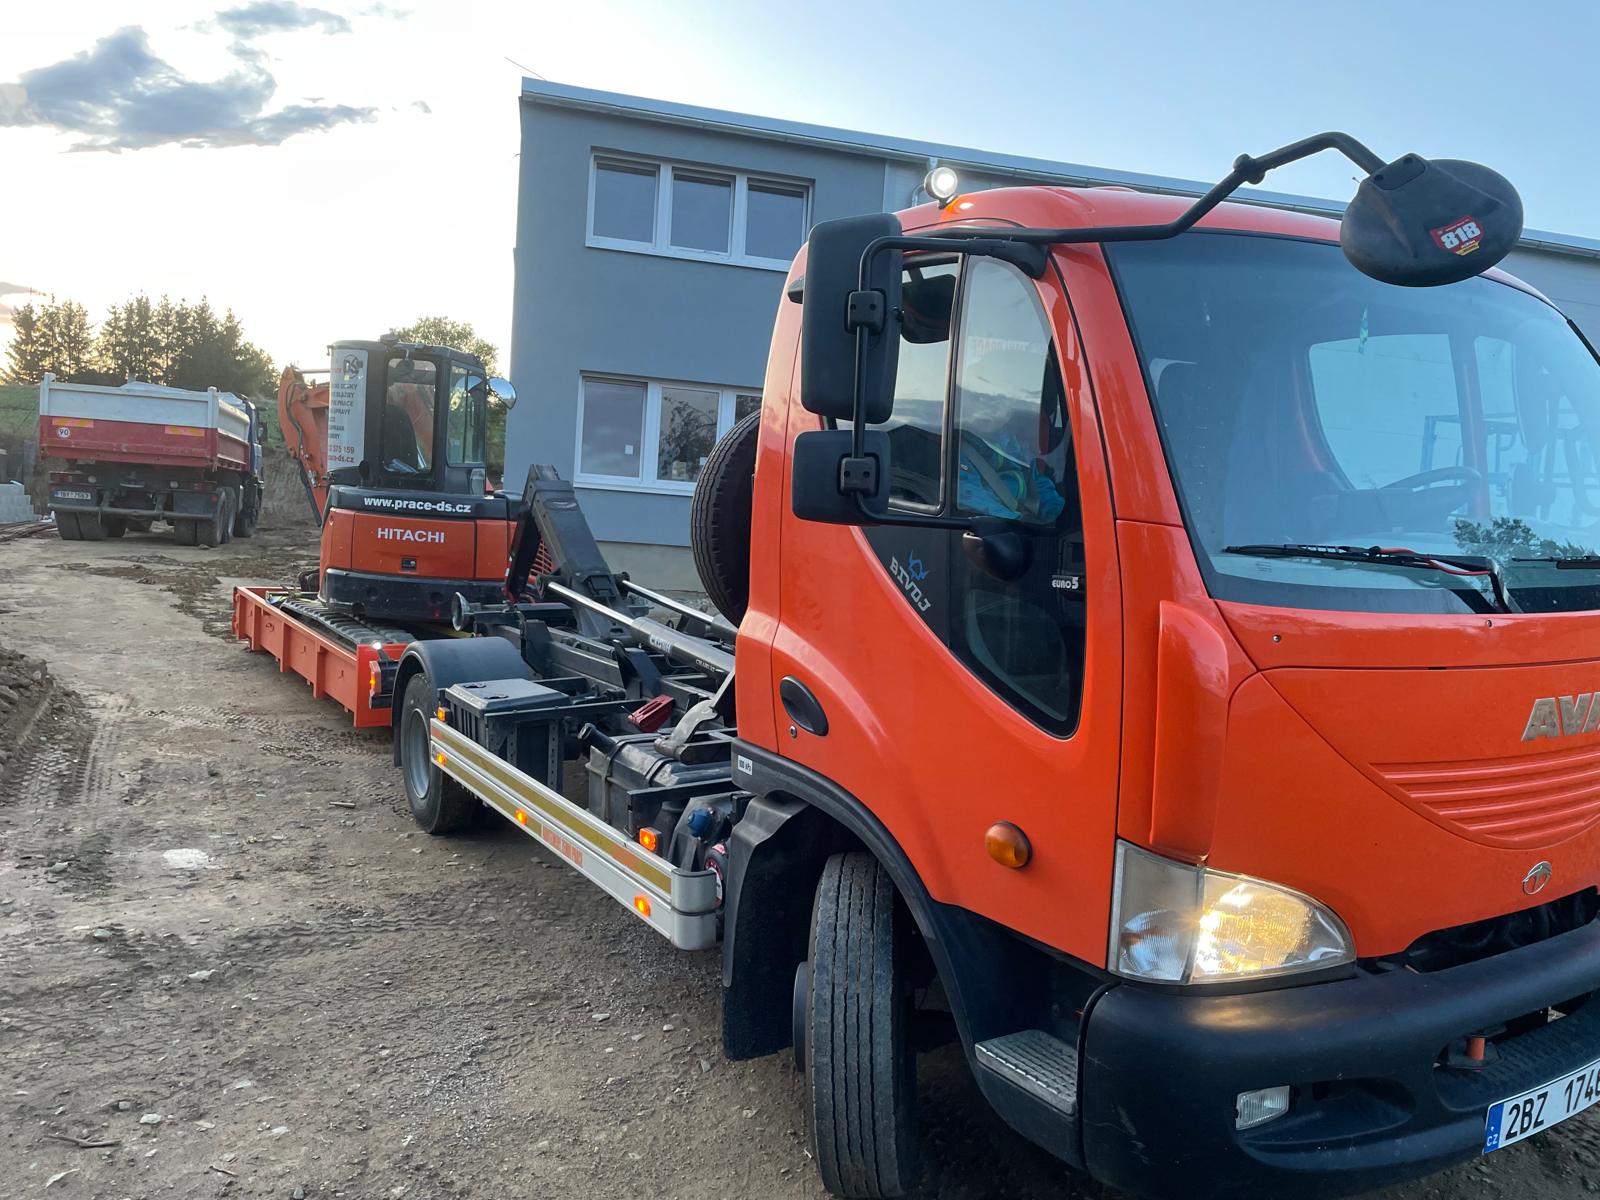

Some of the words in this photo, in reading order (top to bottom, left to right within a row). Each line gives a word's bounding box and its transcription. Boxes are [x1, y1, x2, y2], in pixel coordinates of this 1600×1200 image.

[1441, 222, 1481, 249] 818
[364, 497, 472, 513] www.prace-ds.cz
[377, 527, 446, 544] HITACHI
[1505, 1091, 1549, 1141] 2BZ
[1486, 1133, 1499, 1147] CZ
